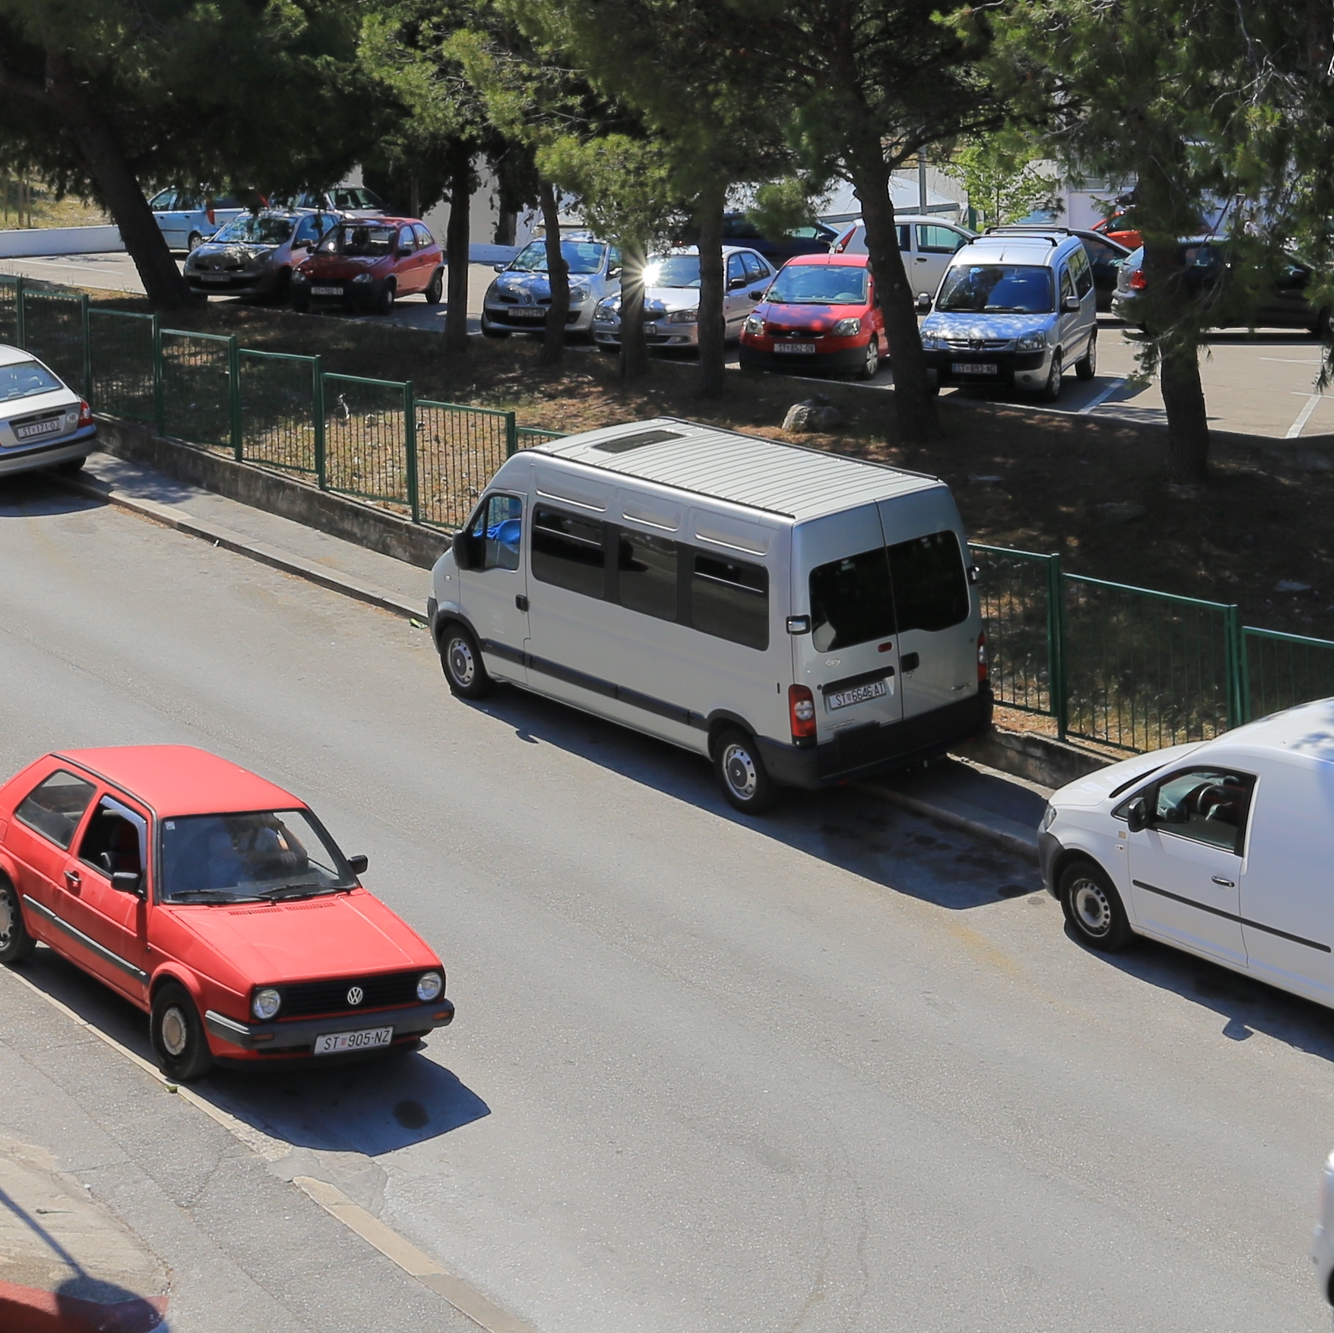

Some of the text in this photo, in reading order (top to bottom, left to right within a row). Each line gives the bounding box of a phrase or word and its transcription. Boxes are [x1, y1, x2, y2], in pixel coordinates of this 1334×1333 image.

[23, 427, 31, 436] ST
[835, 693, 846, 706] ST
[323, 1030, 390, 1051] ST 905-NZ
